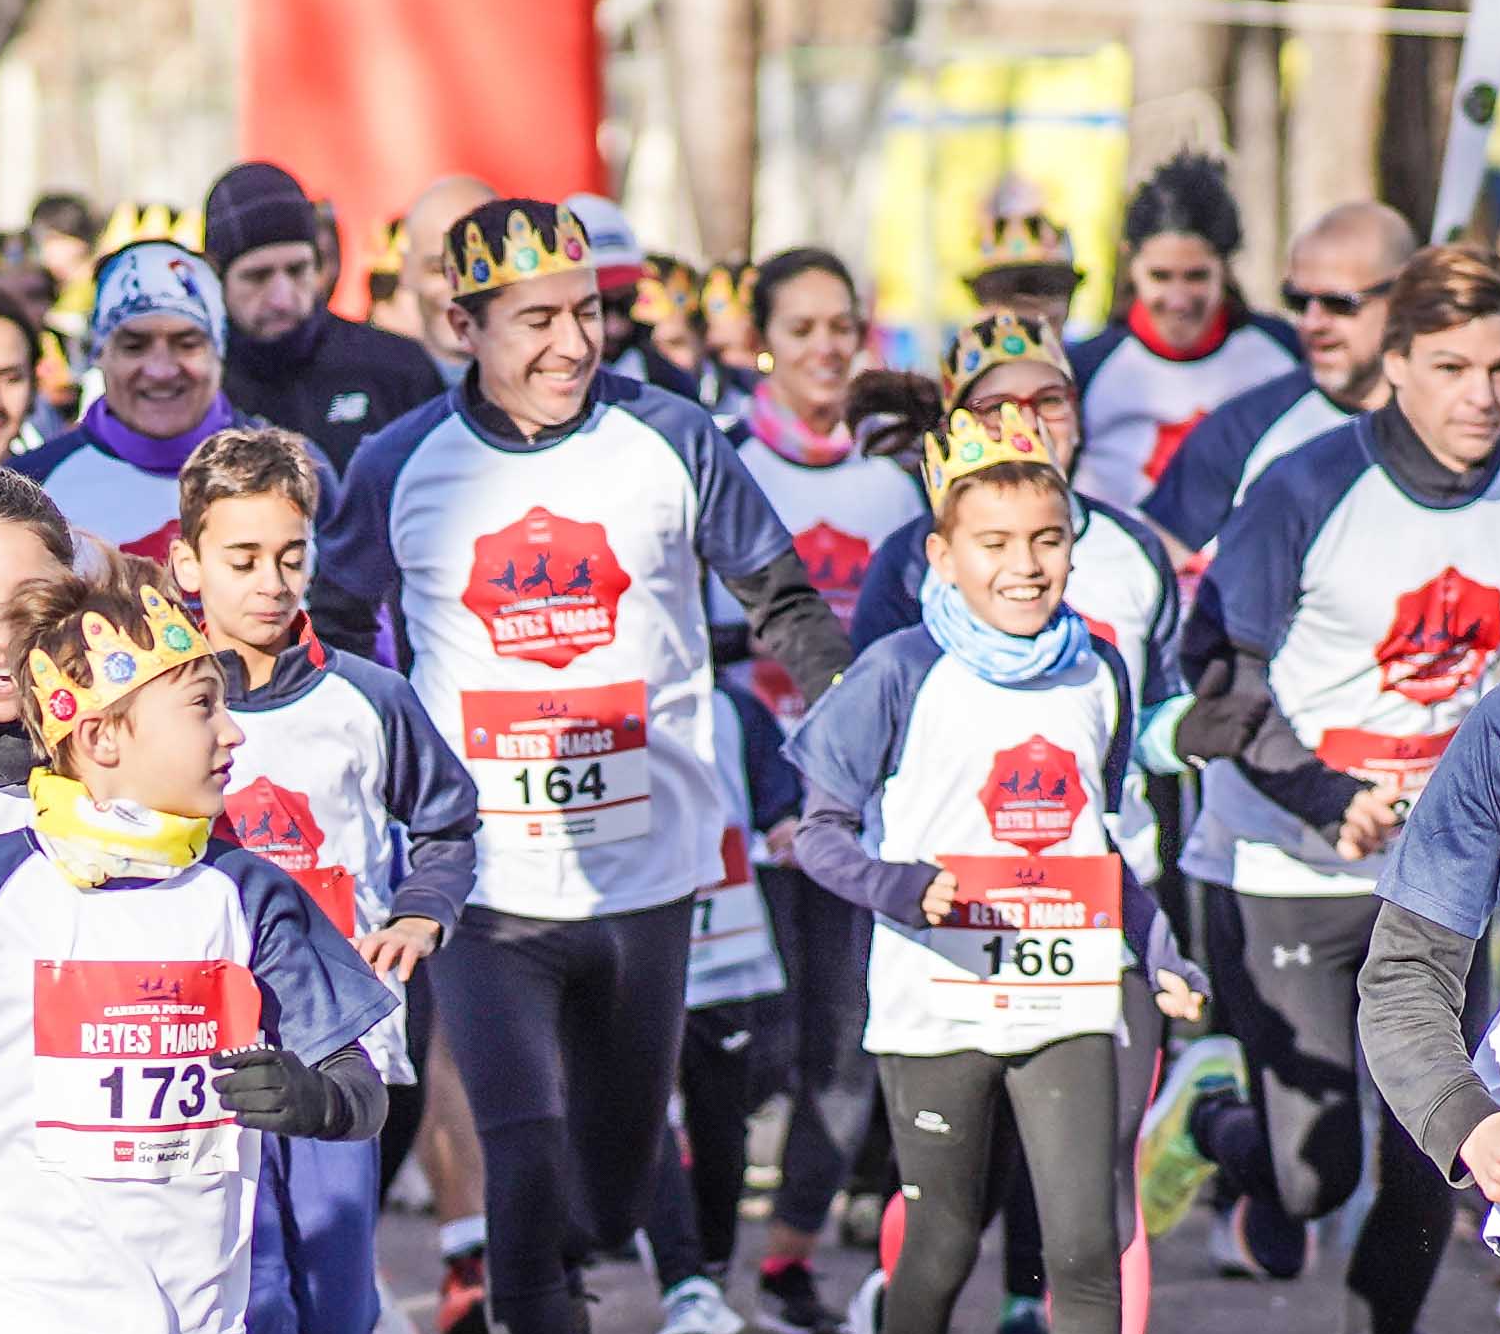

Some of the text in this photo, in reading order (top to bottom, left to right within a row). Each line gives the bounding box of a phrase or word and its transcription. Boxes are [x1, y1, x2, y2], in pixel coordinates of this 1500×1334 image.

[513, 761, 607, 806] 164
[982, 935, 1075, 977] 166
[103, 1004, 160, 1018] CARRERA
[80, 1022, 152, 1055] REYES
[159, 1020, 219, 1055] MAGOS
[99, 1063, 207, 1120] 173
[138, 1149, 190, 1163] de Madrid
